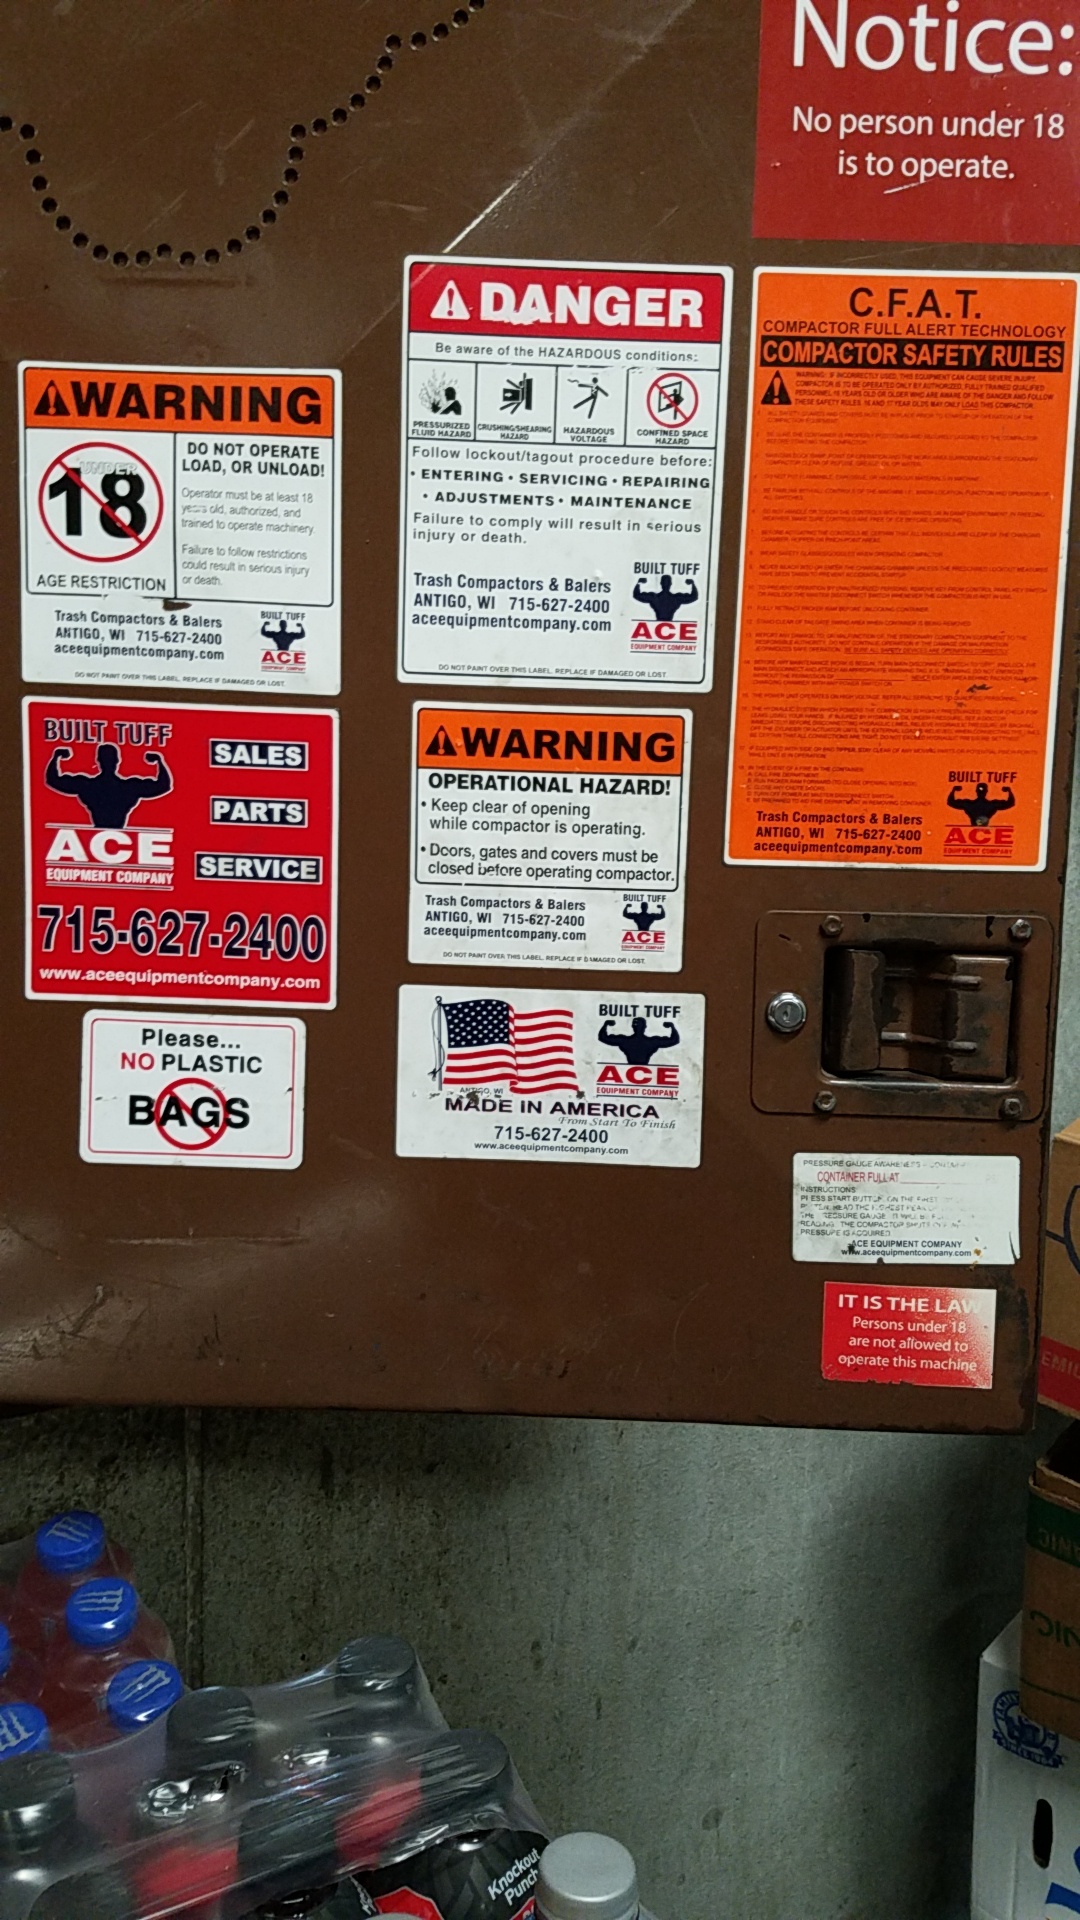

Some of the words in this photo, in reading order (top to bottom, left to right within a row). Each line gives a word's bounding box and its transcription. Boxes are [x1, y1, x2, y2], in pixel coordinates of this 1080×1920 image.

[793, 0, 1074, 76] Notice:
[793, 106, 831, 132] No
[839, 114, 932, 140] person
[942, 110, 1024, 137] under
[1033, 113, 1064, 138] 18
[838, 149, 857, 174] is
[864, 152, 893, 175] to
[900, 156, 1014, 182] operate.
[480, 282, 704, 328] DANGER
[849, 287, 981, 319] C.F.A.T.
[763, 320, 859, 336] COMPACTOR
[865, 322, 901, 336] FULL
[907, 324, 955, 337] ALERT
[960, 325, 1067, 339] TECHNOLOGY
[435, 342, 451, 353] Be
[455, 345, 492, 354] aware
[497, 345, 510, 355] of
[513, 346, 533, 356] the
[538, 347, 620, 359] HAZARDOUS
[762, 340, 898, 365] COMPACTOR
[902, 342, 987, 367] SAFETY
[991, 345, 1062, 368] RULES
[70, 381, 322, 425] WARNING
[563, 427, 615, 435] HAZARDOUS
[570, 435, 607, 443] VOLTAGE
[637, 429, 680, 437] CONFINED
[682, 430, 708, 438] SPACE
[187, 441, 209, 455] DO
[213, 442, 245, 457] NOT
[249, 443, 320, 460] OPERATE
[655, 437, 690, 446] HAZARD
[412, 445, 460, 458] Follow
[466, 448, 573, 464] lockout/tagout
[578, 454, 654, 465] procedure
[660, 454, 711, 466] before:
[182, 459, 225, 474] LOAD,
[231, 460, 251, 473] OR
[257, 460, 326, 478] UNLOAD!
[421, 468, 503, 481] ENTERING
[519, 473, 607, 485] SERVICING
[622, 476, 709, 487] REPAIRING
[48, 467, 147, 538] 18
[434, 491, 554, 506] ADJUSTMENTS
[570, 495, 691, 510] MAINTENANCE
[413, 512, 463, 524] Failure
[469, 515, 483, 525] to
[489, 517, 542, 530] comply
[547, 517, 572, 528] will
[579, 519, 621, 530] result
[627, 519, 640, 530] in
[413, 528, 455, 543] injury
[460, 532, 475, 541] or
[481, 531, 526, 543] death.
[634, 562, 666, 574] BUILT
[670, 563, 700, 575] TUFF
[36, 574, 66, 587] AGE
[71, 574, 165, 591] RESTRICTION
[413, 572, 451, 586] Trash
[457, 574, 543, 591] Compactors
[548, 577, 558, 591] &
[564, 578, 610, 592] Balers
[413, 593, 471, 609] ANTIGO,
[477, 595, 495, 609] WI
[509, 596, 609, 612] 715-627-2400
[411, 614, 611, 632] aceequipmentcompany.com
[630, 622, 698, 641] ACE
[43, 717, 108, 743] BUILT
[114, 721, 173, 747] TUFF
[461, 726, 676, 763] WARNING
[214, 743, 303, 767] SALES
[428, 773, 572, 793] OPERATIONAL
[580, 776, 670, 796] HAZARD!
[213, 801, 303, 824] PARTS
[431, 798, 467, 816] Keep
[472, 800, 508, 813] clear
[512, 800, 526, 813] of
[530, 802, 590, 819] opening
[429, 816, 467, 829] while
[471, 820, 550, 834] compactor
[554, 819, 567, 833] is
[571, 822, 645, 838] operating.
[45, 829, 174, 865] ACE
[479, 846, 517, 861] gates
[520, 846, 547, 859] and
[550, 850, 598, 861] covers
[602, 850, 637, 862] must
[641, 849, 658, 862] be
[46, 867, 113, 882] EQUIPMENT
[115, 870, 174, 885] COMPANY
[199, 856, 318, 881] SERVICE
[428, 861, 473, 874] closed
[478, 862, 522, 876] before
[525, 865, 591, 882] operating
[595, 868, 677, 884] compactor.
[425, 894, 457, 908] Trash
[460, 895, 530, 910] Compactors
[534, 898, 543, 910] &
[547, 898, 585, 911] Balers
[623, 893, 645, 902] BUILT
[647, 894, 667, 903] TUFF
[425, 910, 472, 927] ANTIGO,
[476, 912, 491, 923] WI
[502, 913, 584, 926] 715-627-2400
[37, 904, 326, 962] 715-627-2400
[423, 926, 586, 941] aceequipmentcompany.com
[622, 931, 666, 944] ACE
[39, 967, 321, 990] www.aceequipmentcompany.com
[598, 1003, 640, 1017] BUILT
[643, 1005, 681, 1019] TUFF
[141, 1028, 241, 1049] Please...
[121, 1052, 154, 1070] NO
[161, 1053, 261, 1073] PLASTIC
[597, 1065, 680, 1086] ACE
[596, 1086, 640, 1096] EQUIPMENT
[641, 1088, 679, 1097] COMPANY
[129, 1095, 250, 1129] BAGS
[443, 1097, 512, 1113] MADE
[520, 1100, 541, 1113] IN
[549, 1101, 659, 1119] AMERICA
[558, 1116, 587, 1127] From
[589, 1116, 618, 1128] Start
[622, 1117, 636, 1127] To
[640, 1117, 675, 1128] Finish
[493, 1125, 609, 1143] 715-627-2400
[473, 1143, 629, 1155] www.aceequipmentcompany.com
[817, 1171, 866, 1183] CONTAINER
[867, 1172, 888, 1183] FULL
[889, 1172, 900, 1183] AT
[851, 1240, 869, 1248] ACE
[870, 1240, 919, 1248] EQUIPMENT
[921, 1240, 962, 1249] COMPANY
[838, 1294, 858, 1308] IT
[863, 1295, 882, 1310] IS
[886, 1296, 929, 1313] THE
[935, 1298, 982, 1314] LAW
[852, 1316, 903, 1331] Persons
[907, 1320, 948, 1333] under
[951, 1321, 967, 1334] 18
[849, 1336, 870, 1347] are
[873, 1338, 897, 1349] not
[899, 1336, 951, 1352] allowed
[954, 1341, 969, 1352] to
[838, 1354, 890, 1367] operate
[893, 1356, 917, 1369] this
[920, 1358, 977, 1371] machine
[487, 1847, 541, 1901] Knockout
